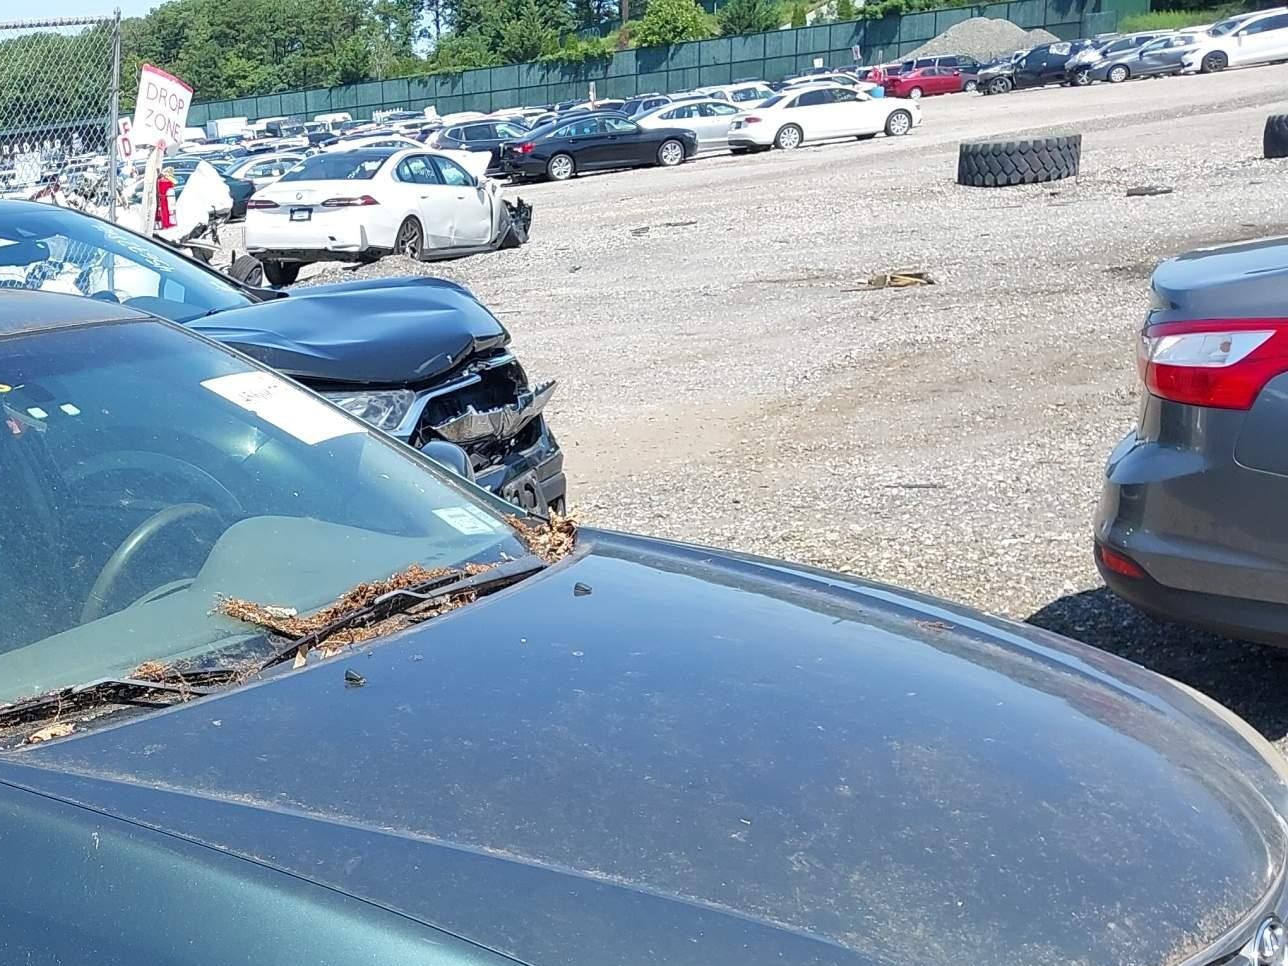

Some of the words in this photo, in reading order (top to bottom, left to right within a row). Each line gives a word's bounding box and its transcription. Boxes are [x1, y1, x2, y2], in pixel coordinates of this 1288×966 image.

[145, 81, 185, 115] DROP
[144, 108, 182, 144] ZONE
[121, 136, 132, 158] D
